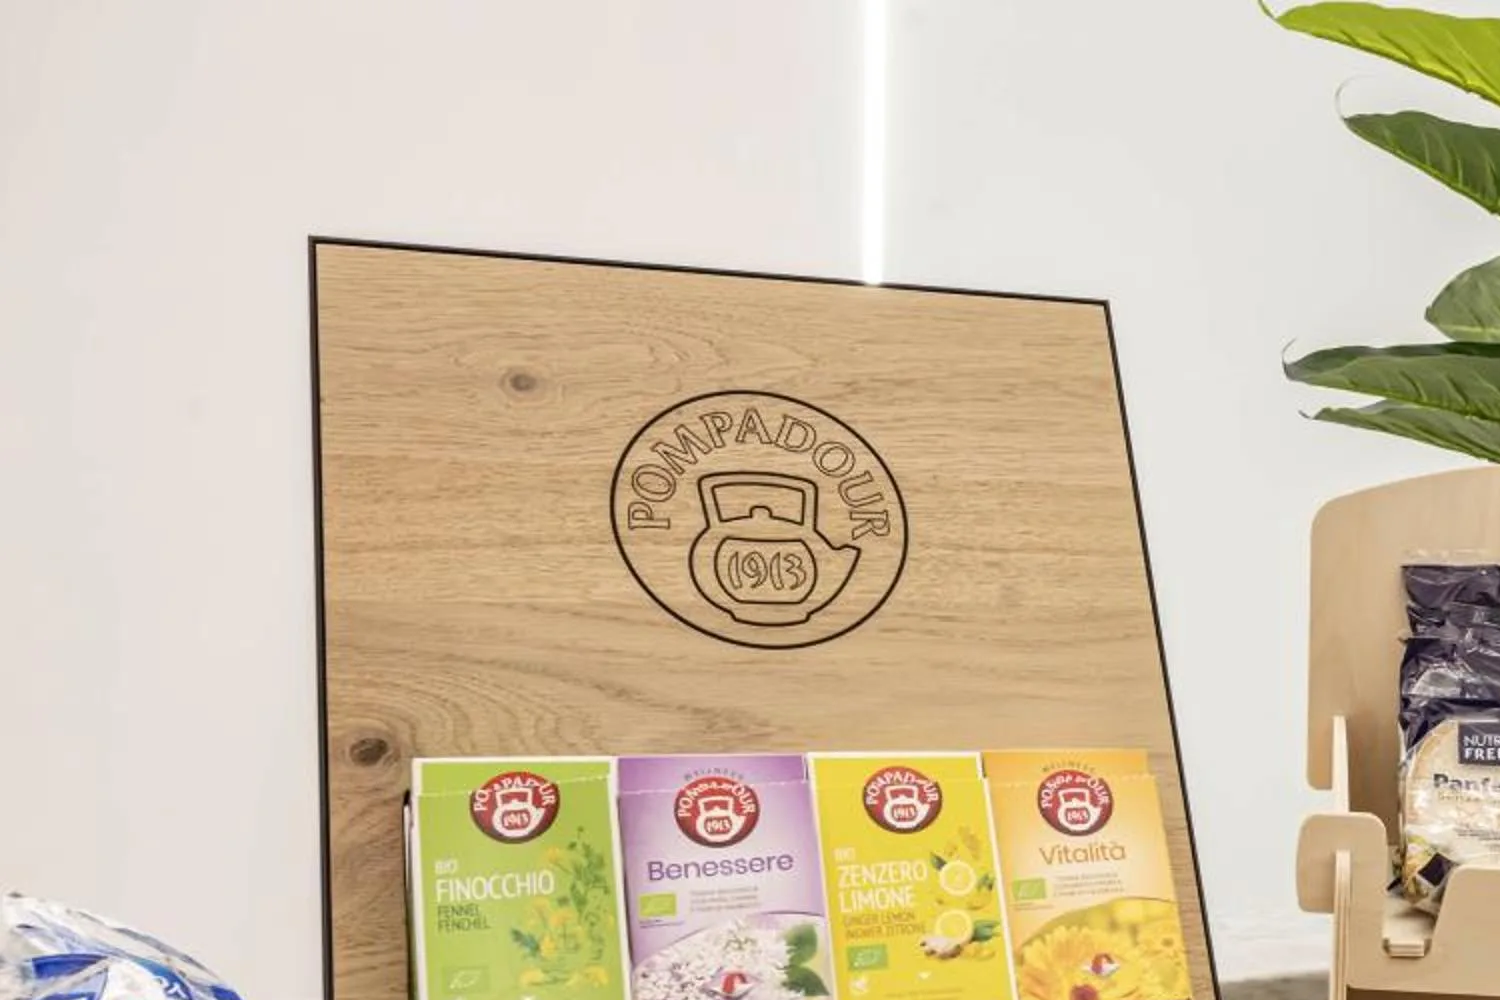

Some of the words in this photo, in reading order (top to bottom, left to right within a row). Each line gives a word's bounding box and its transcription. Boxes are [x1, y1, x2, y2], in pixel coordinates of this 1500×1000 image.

[627, 407, 891, 540] POMPADOUR
[727, 551, 807, 590] 1913
[473, 776, 557, 812] POPADUR
[677, 781, 756, 817] POMOUR
[866, 771, 939, 806] POPADUR
[1041, 774, 1110, 809] POOUR
[648, 854, 794, 881] Benessere
[1039, 841, 1127, 866] Vitalità
[436, 869, 555, 903] FINOCCHIO
[838, 859, 928, 889] ZENZERO
[839, 886, 916, 913] LIMONE
